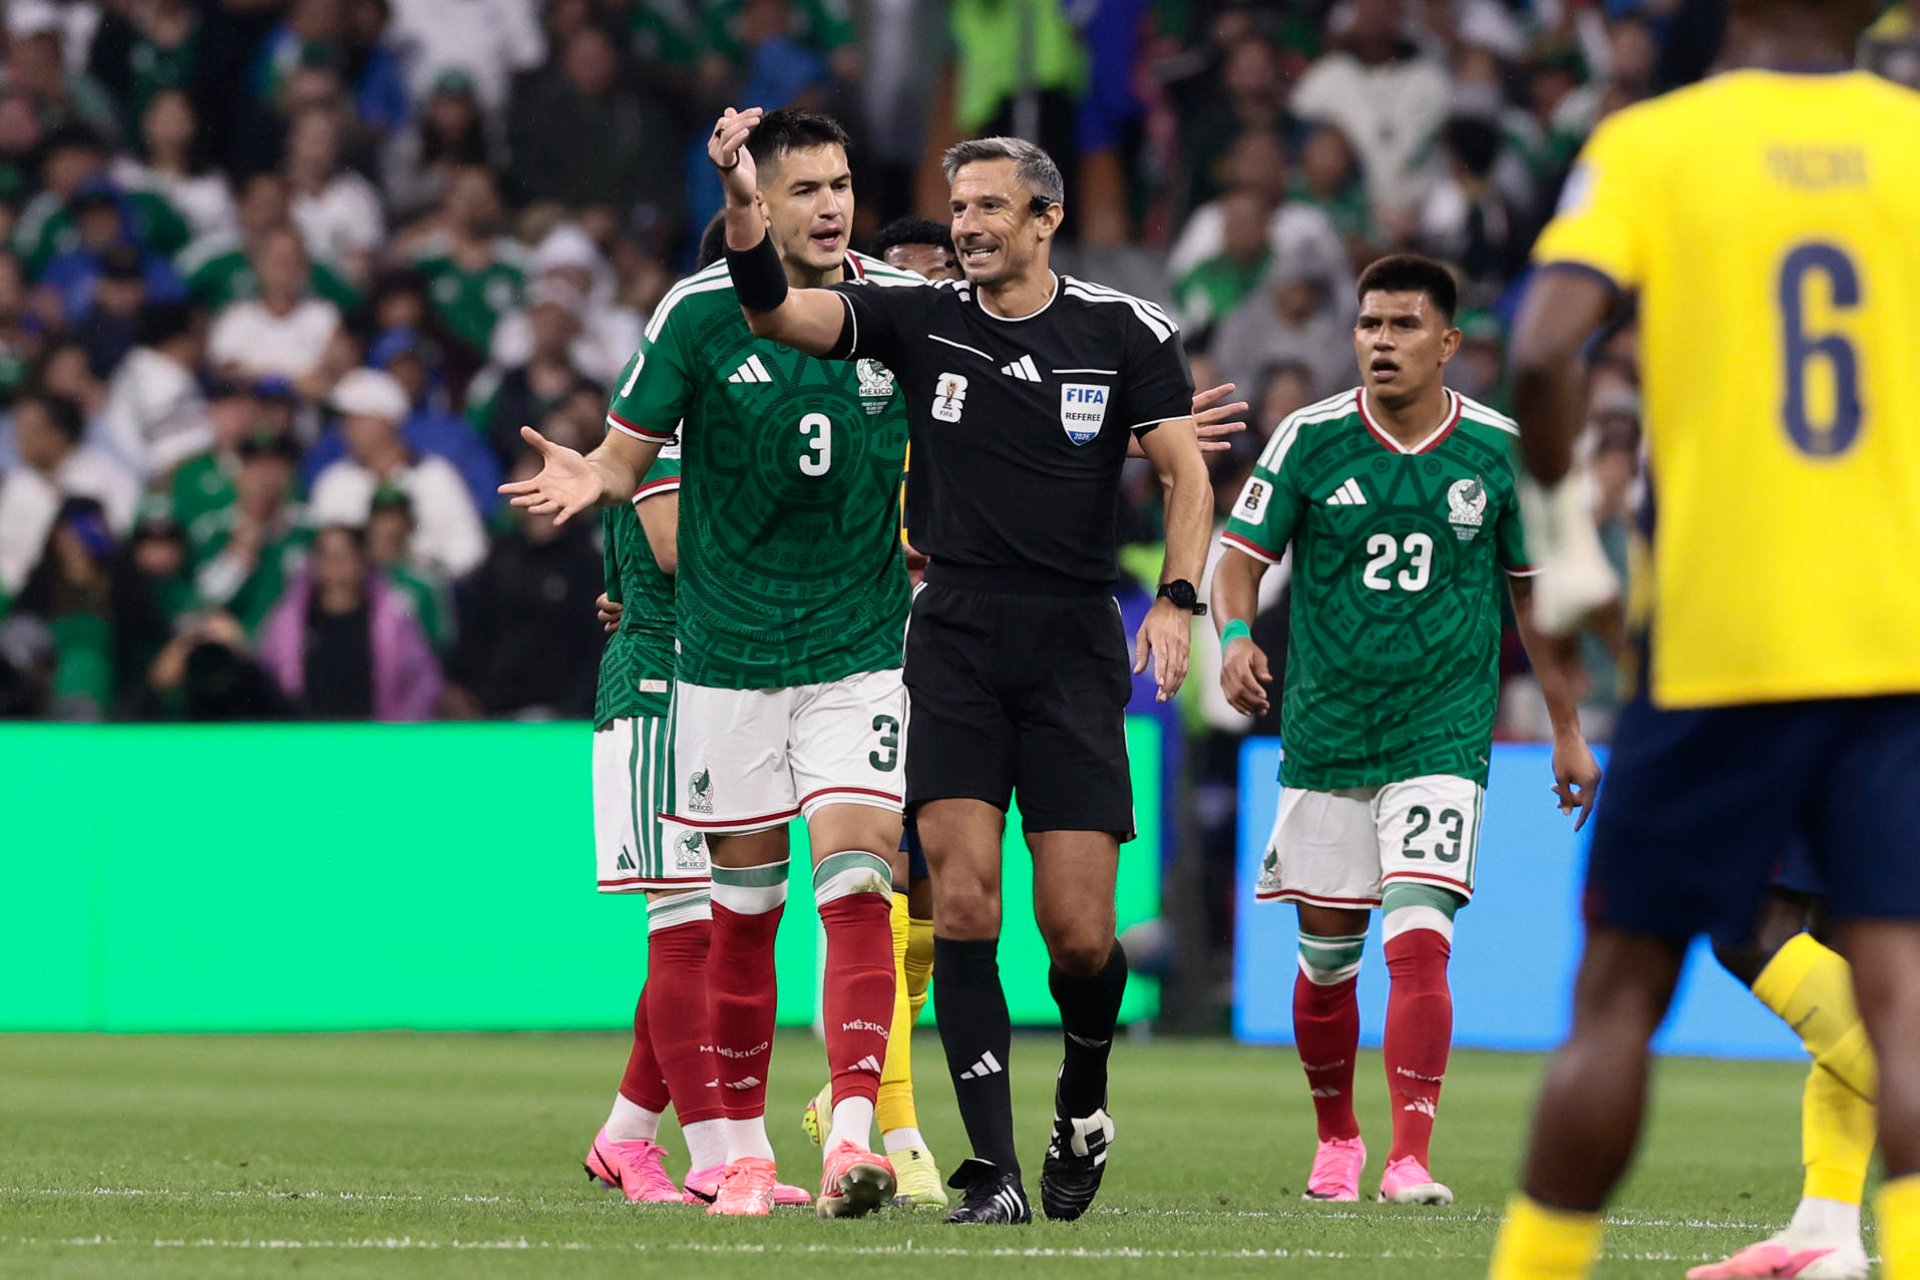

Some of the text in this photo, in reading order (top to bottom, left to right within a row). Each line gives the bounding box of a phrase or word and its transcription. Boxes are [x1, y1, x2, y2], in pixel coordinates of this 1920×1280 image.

[1779, 243, 1860, 458] 6
[1065, 412, 1102, 422] REFEREE
[1066, 388, 1104, 404] FIFA
[799, 412, 831, 476] 3
[1363, 532, 1433, 592] 23
[869, 714, 900, 772] 3
[1402, 805, 1464, 863] 23
[842, 1019, 889, 1041] MÉXICO
